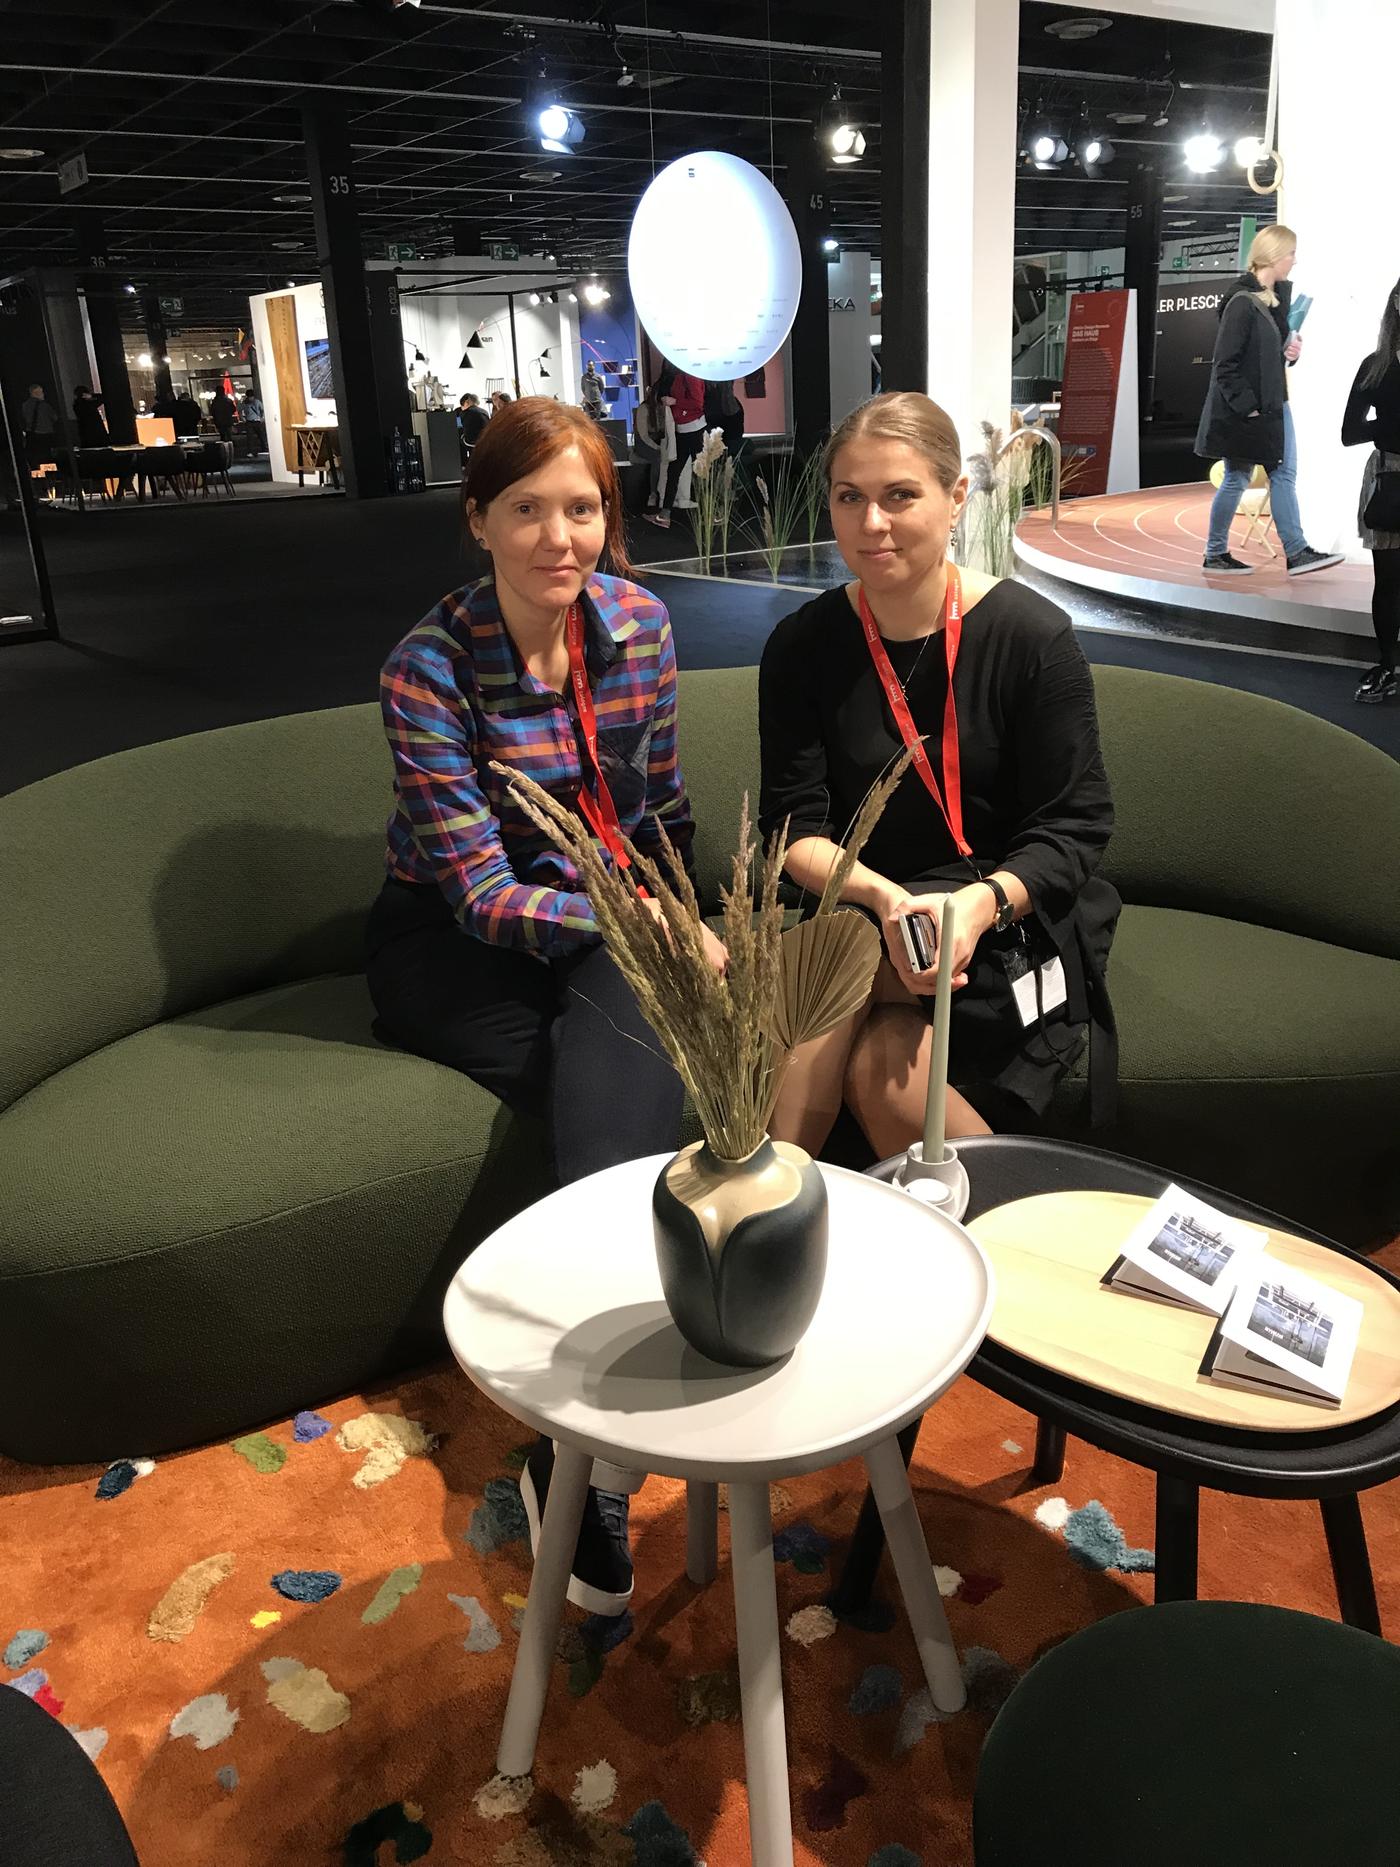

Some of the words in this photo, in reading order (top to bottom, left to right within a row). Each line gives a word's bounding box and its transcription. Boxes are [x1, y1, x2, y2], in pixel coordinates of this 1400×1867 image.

[329, 175, 349, 194] 35
[809, 194, 823, 210] 45
[1130, 204, 1143, 219] 55
[1156, 298, 1175, 313] ER
